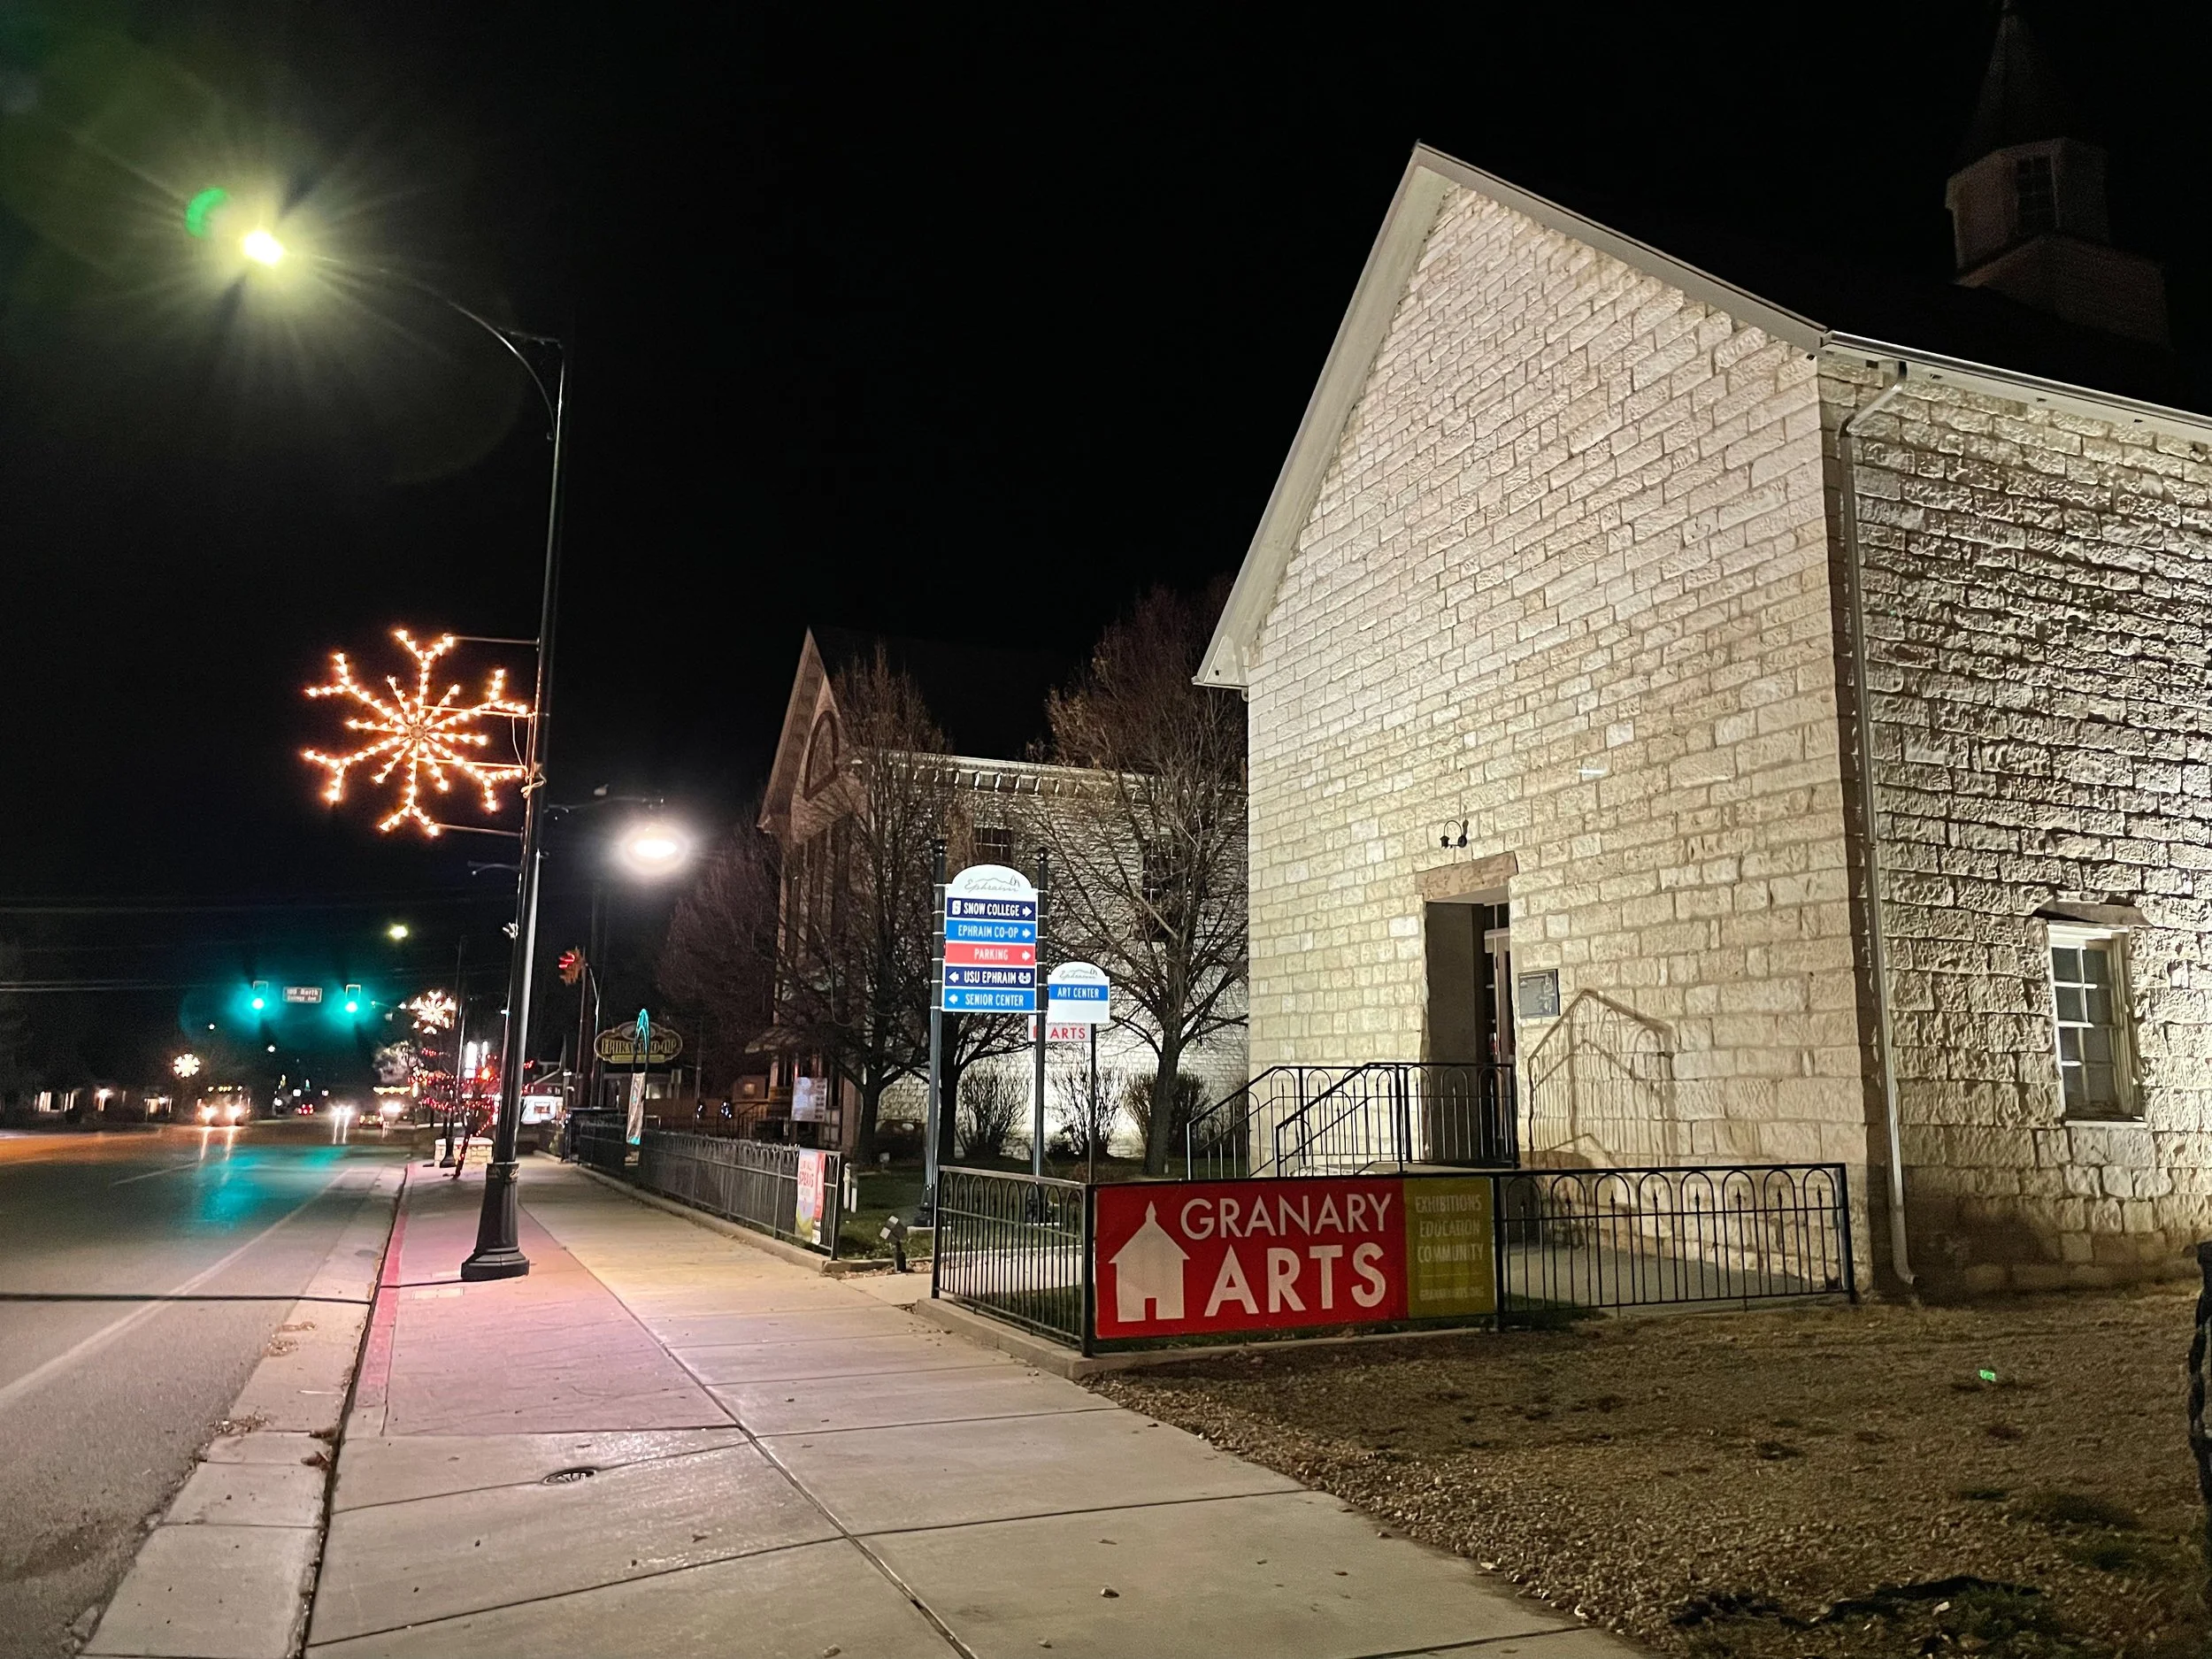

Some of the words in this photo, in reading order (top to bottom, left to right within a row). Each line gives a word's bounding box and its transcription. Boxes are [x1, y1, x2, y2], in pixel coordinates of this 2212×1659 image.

[964, 880, 1019, 893] Ephraim
[964, 902, 987, 915] SNOW
[987, 903, 1020, 917] COLLEGE
[958, 925, 992, 938] EPHRAIM
[995, 926, 1019, 938] CO-OP
[974, 949, 1008, 960] PARKING
[964, 971, 979, 983] USU
[982, 972, 1017, 984] EPHRAIM
[1057, 987, 1072, 998] ART
[1073, 988, 1099, 998] CENTER
[965, 994, 993, 1006] SENIOR
[995, 995, 1024, 1007] CENTER
[1049, 1027, 1086, 1040] ARTS
[1415, 1193, 1483, 1213] EXHIBITIONS
[1179, 1192, 1394, 1240] GRANARY
[1419, 1218, 1481, 1239] EDUCATION
[1417, 1243, 1485, 1263] COMMUNITY
[1202, 1241, 1387, 1317] ARTS
